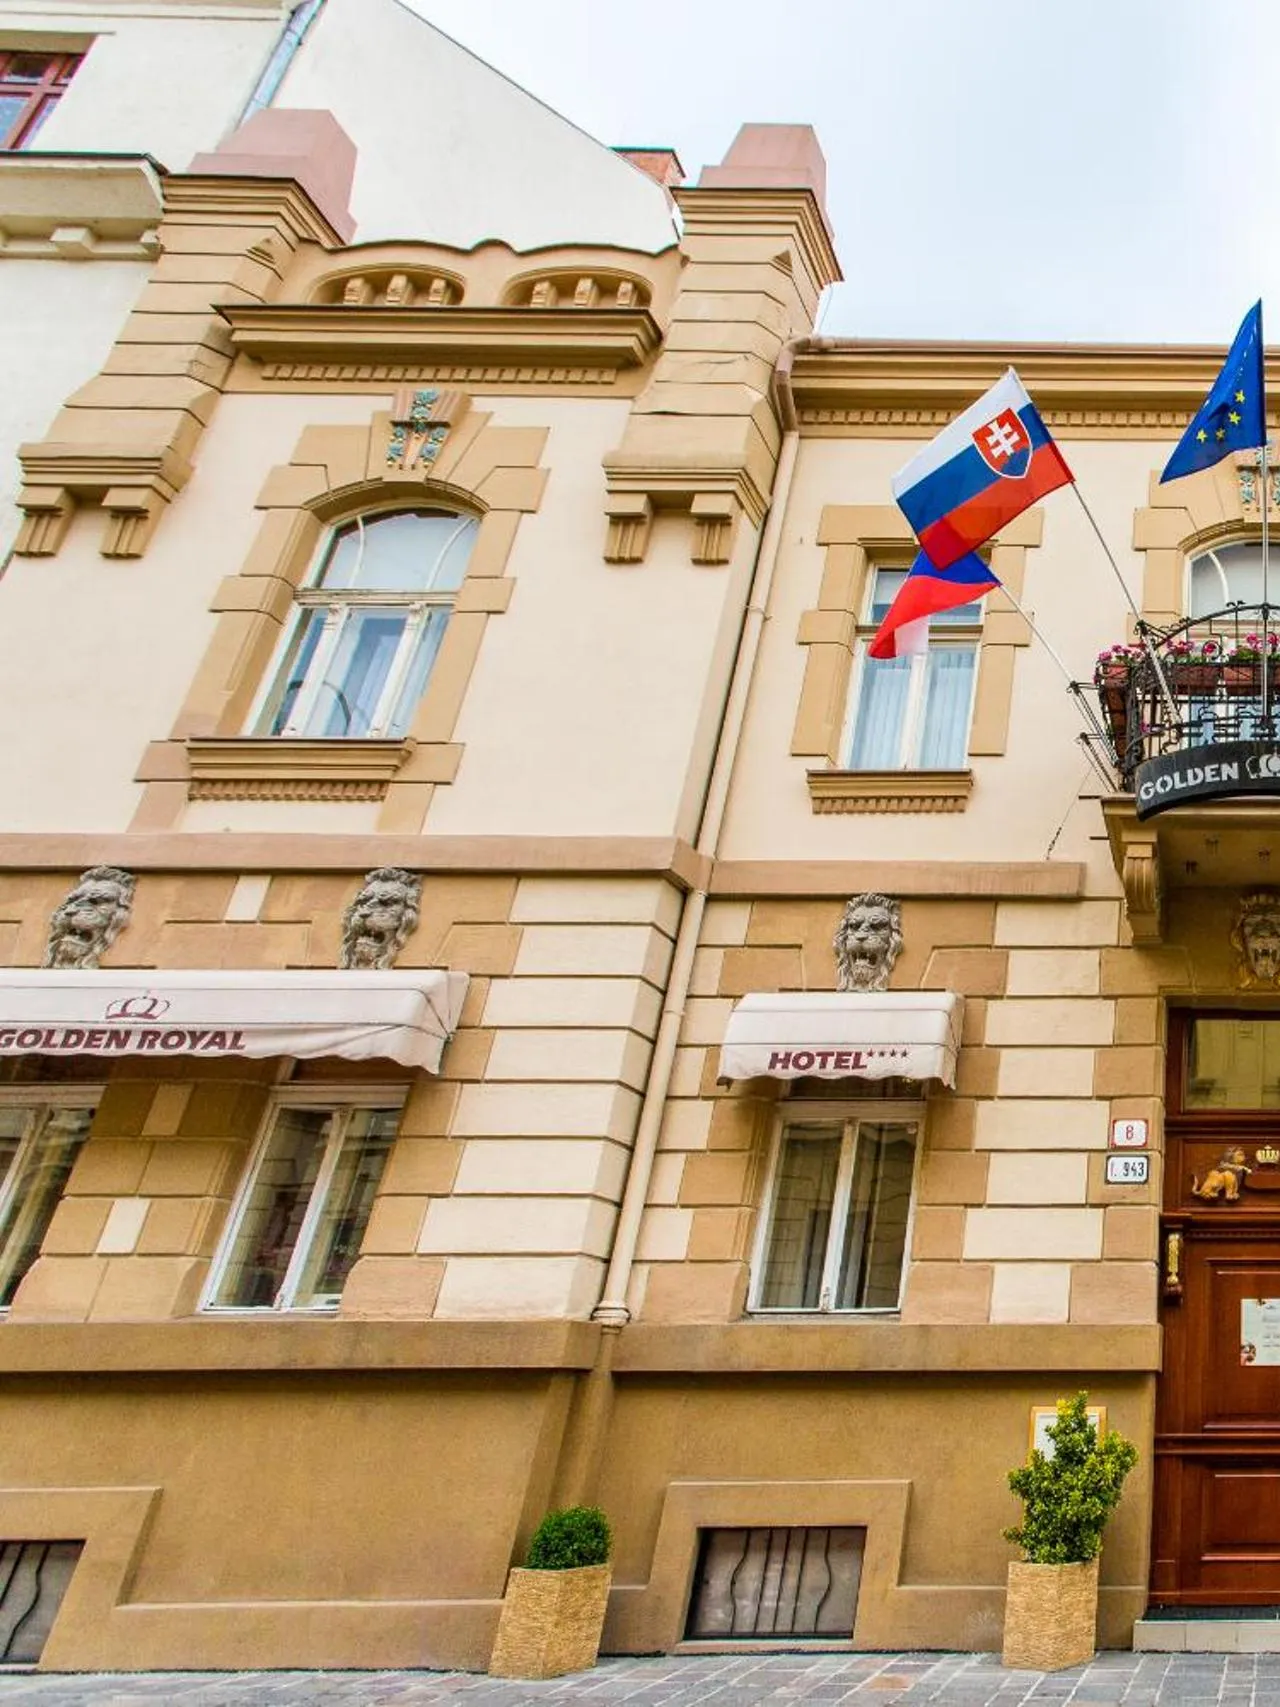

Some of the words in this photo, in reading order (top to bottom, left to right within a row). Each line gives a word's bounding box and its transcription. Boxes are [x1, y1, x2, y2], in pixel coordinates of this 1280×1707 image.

[1139, 762, 1239, 801] GOLDEN
[0, 1029, 132, 1048] GOLDEN
[136, 1030, 246, 1050] ROYAL
[1125, 1125, 1134, 1140] 8
[1122, 1161, 1145, 1177] 943
